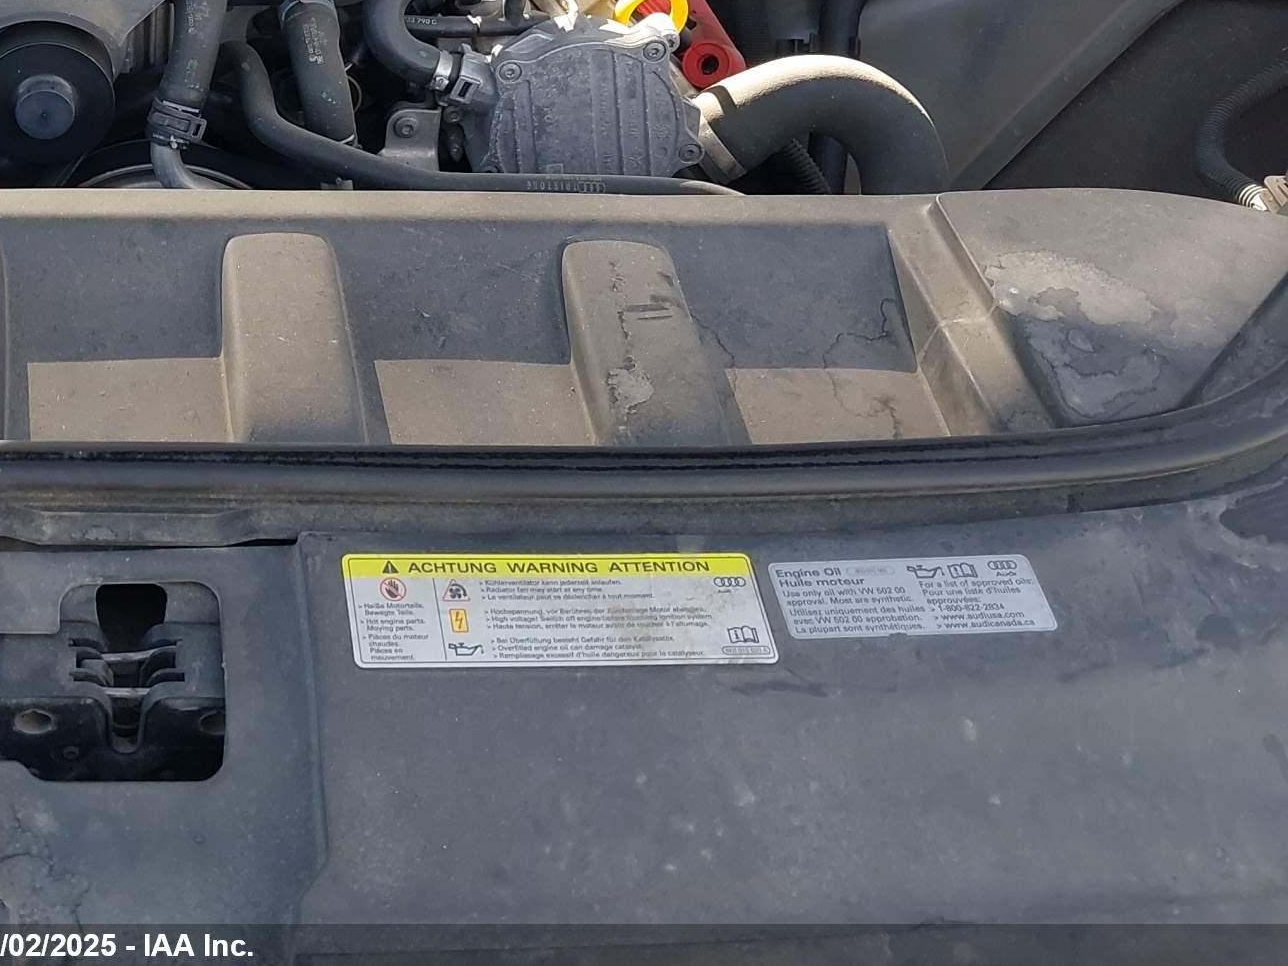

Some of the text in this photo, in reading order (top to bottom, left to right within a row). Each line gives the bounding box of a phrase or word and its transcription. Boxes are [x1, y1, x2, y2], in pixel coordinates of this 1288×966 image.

[408, 561, 710, 573] ACHTUNG WARNING ATTENTION
[776, 567, 841, 579] Engine Oil
[779, 578, 865, 587] Huile moteur
[972, 579, 1013, 588] approved
[802, 589, 821, 598] only
[824, 588, 835, 596] oil
[838, 587, 857, 595] with
[876, 586, 893, 594] 502
[895, 586, 906, 594] 00
[922, 588, 943, 596] Pour
[786, 598, 829, 607] approval.
[830, 597, 852, 605] Most
[824, 607, 878, 616] uniquement
[941, 611, 1025, 620] www.audiusa.com
[834, 616, 850, 624] 502
[795, 626, 807, 634] La
[809, 625, 841, 634] plupart
[843, 624, 863, 632] sont
